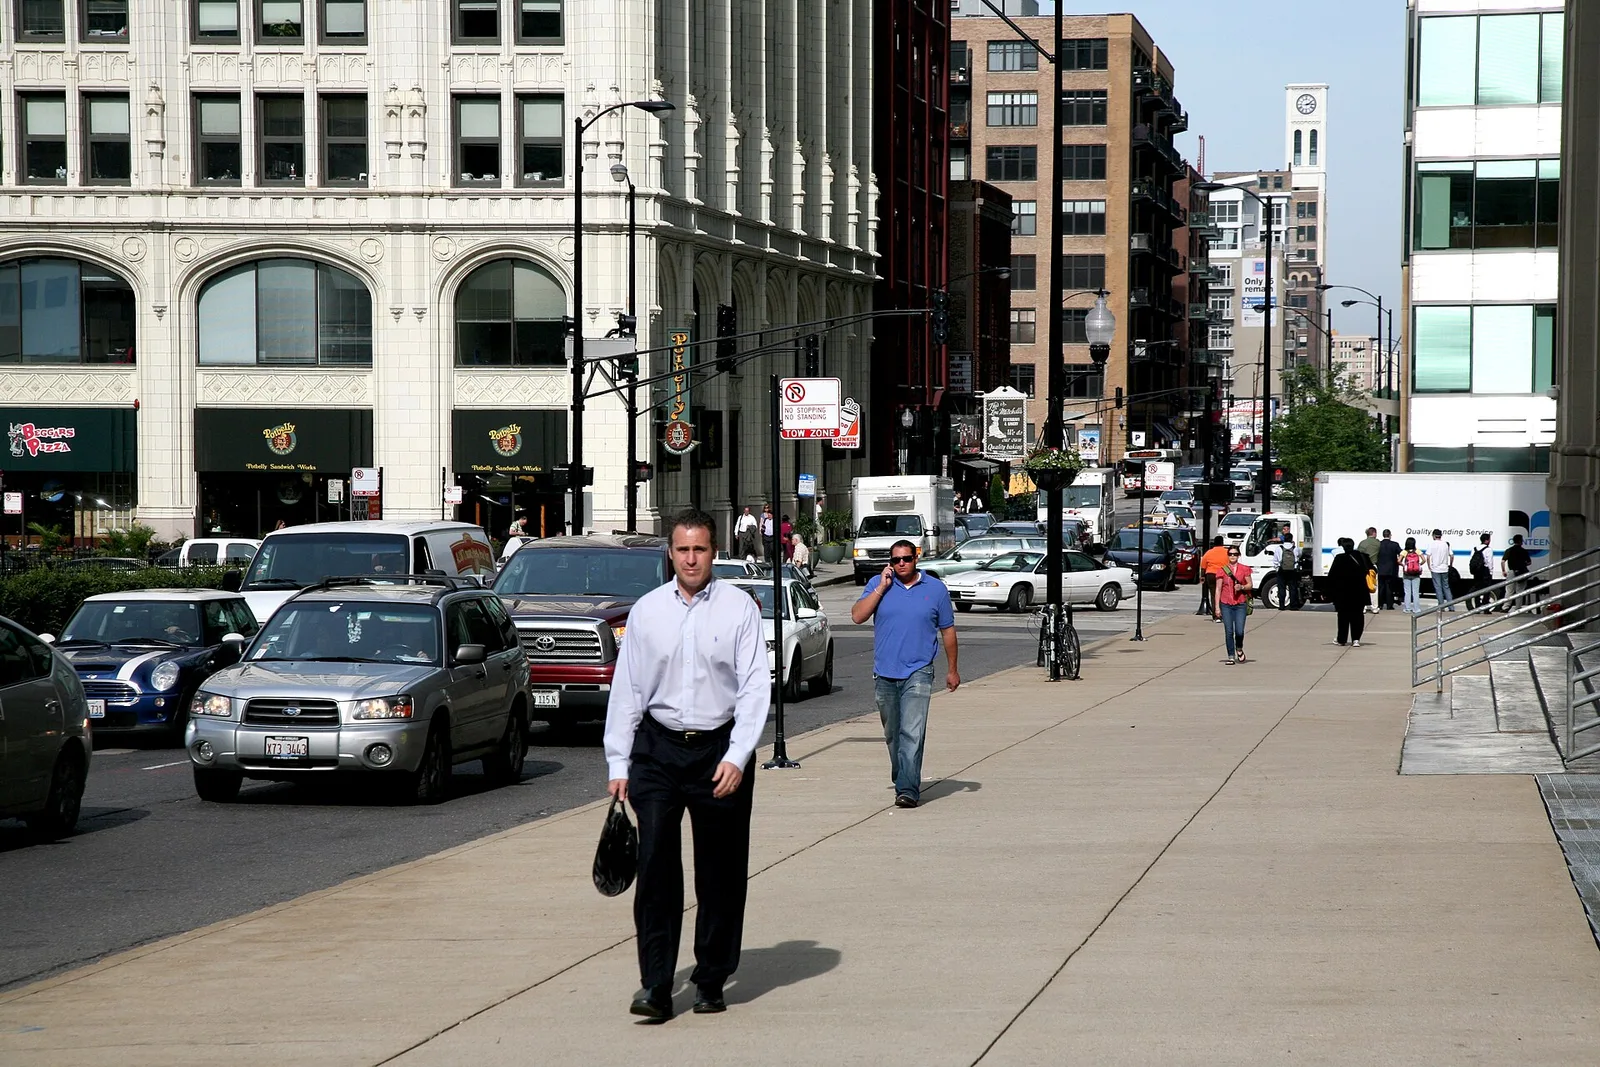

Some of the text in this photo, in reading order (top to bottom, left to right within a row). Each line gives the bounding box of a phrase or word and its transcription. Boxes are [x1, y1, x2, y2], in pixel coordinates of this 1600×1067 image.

[1244, 277, 1263, 286] Only
[263, 422, 296, 439] Potbelly
[489, 423, 521, 439] Potbelly
[785, 429, 835, 437] TOW ZONE
[471, 464, 493, 472] Potbelly
[1405, 527, 1432, 536] Quality
[1465, 528, 1494, 536] Service
[1508, 538, 1550, 546] CNTEEN
[88, 704, 103, 715] 731
[267, 743, 307, 755] X73 3443
